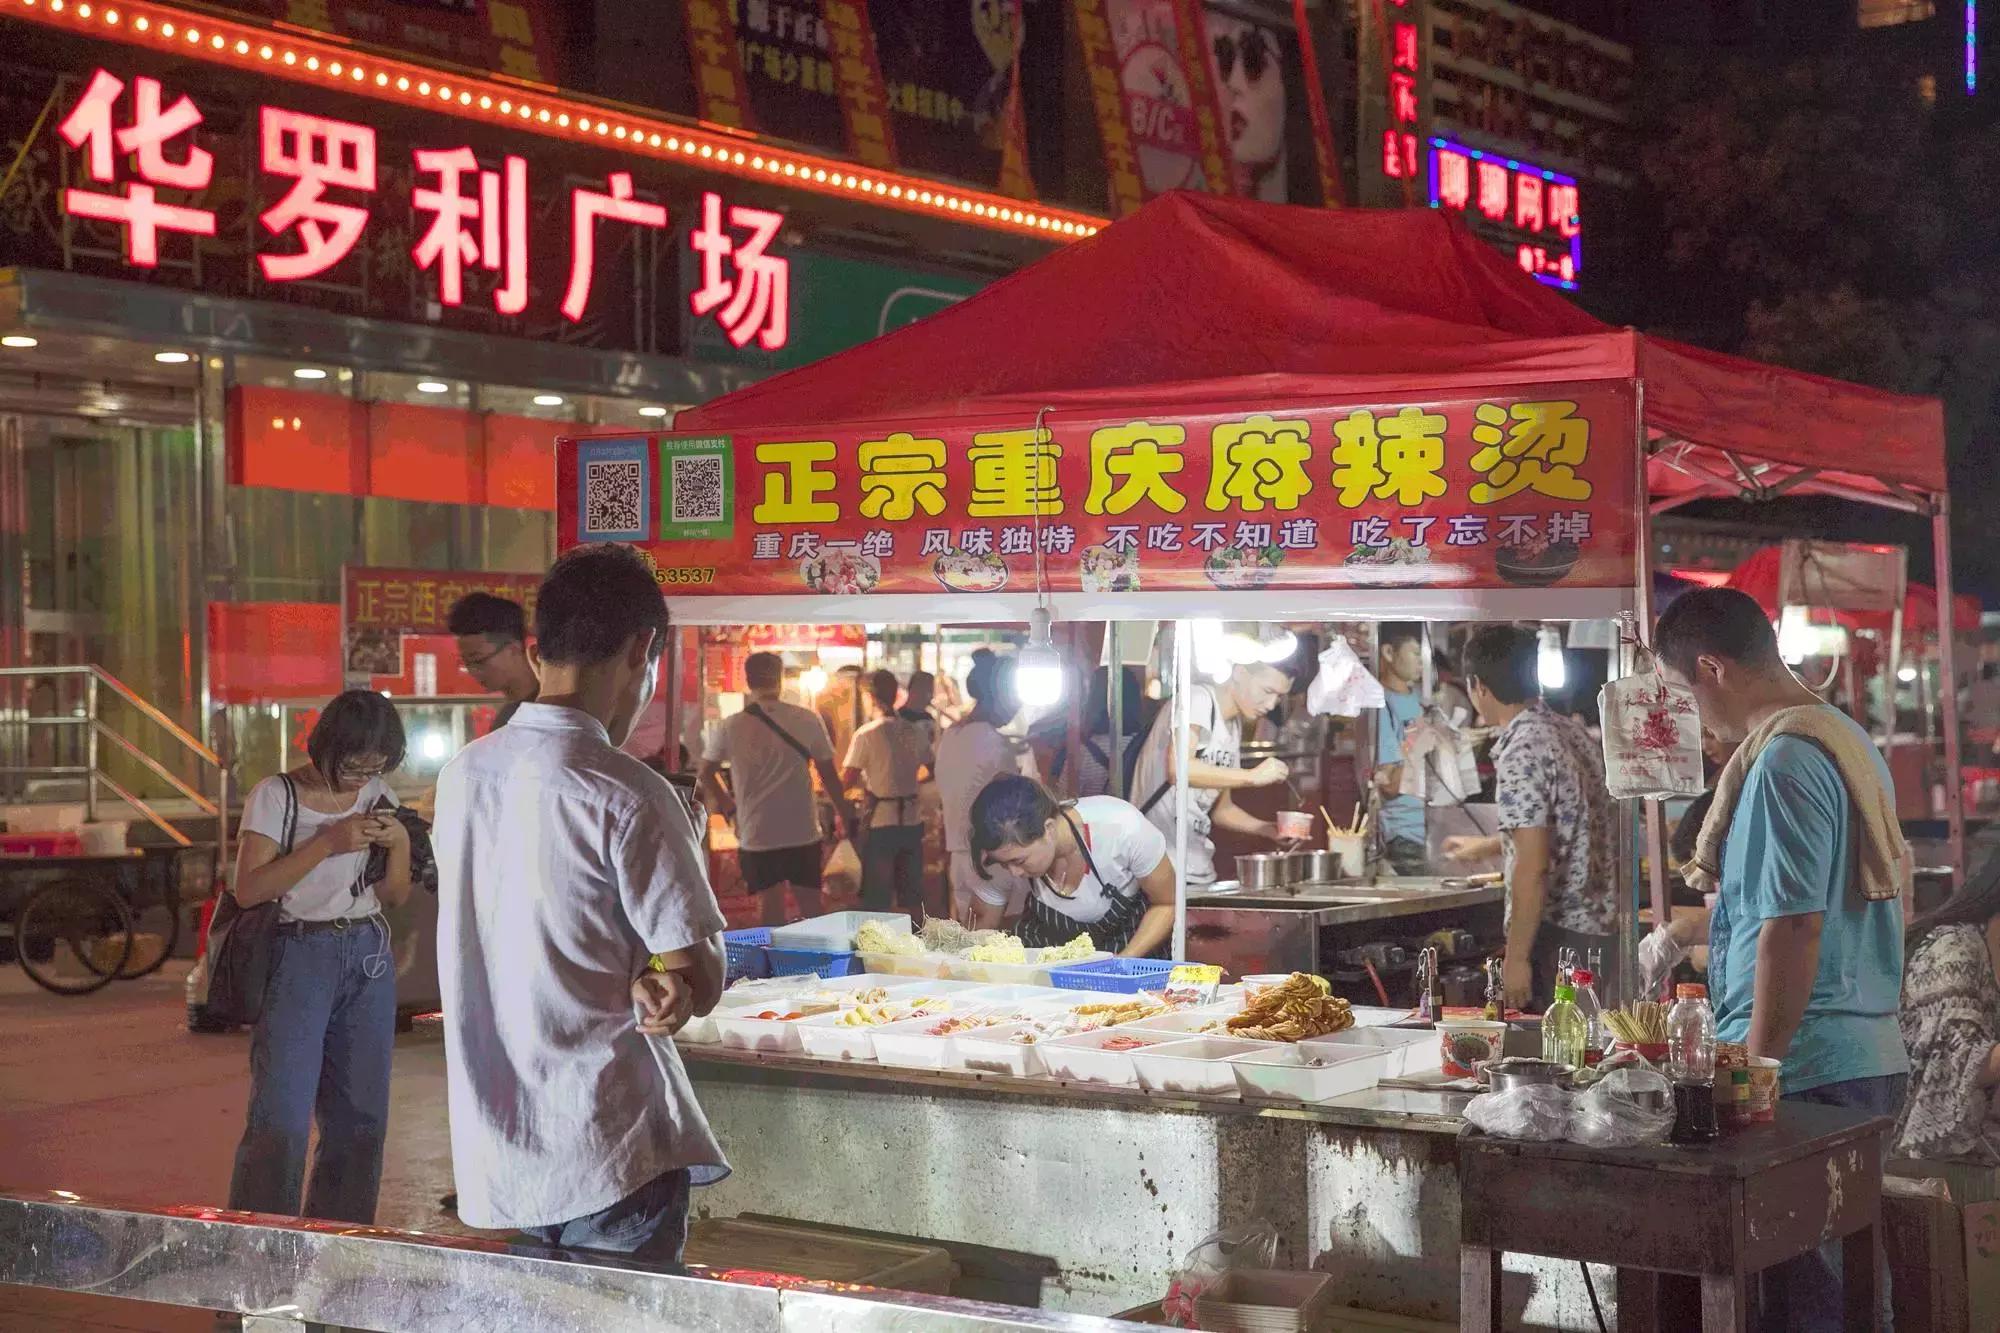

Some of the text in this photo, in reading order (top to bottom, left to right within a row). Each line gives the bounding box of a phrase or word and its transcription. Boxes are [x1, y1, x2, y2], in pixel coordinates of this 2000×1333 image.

[57, 68, 791, 350] 华罗利广场
[752, 399, 1595, 525] 正宗重庆麻辣烫
[752, 530, 895, 560] 重庆一绝
[921, 525, 1077, 558] 风味独特
[1104, 518, 1319, 551] 不吃不知道
[1350, 511, 1594, 548] 吃了忘不掉
